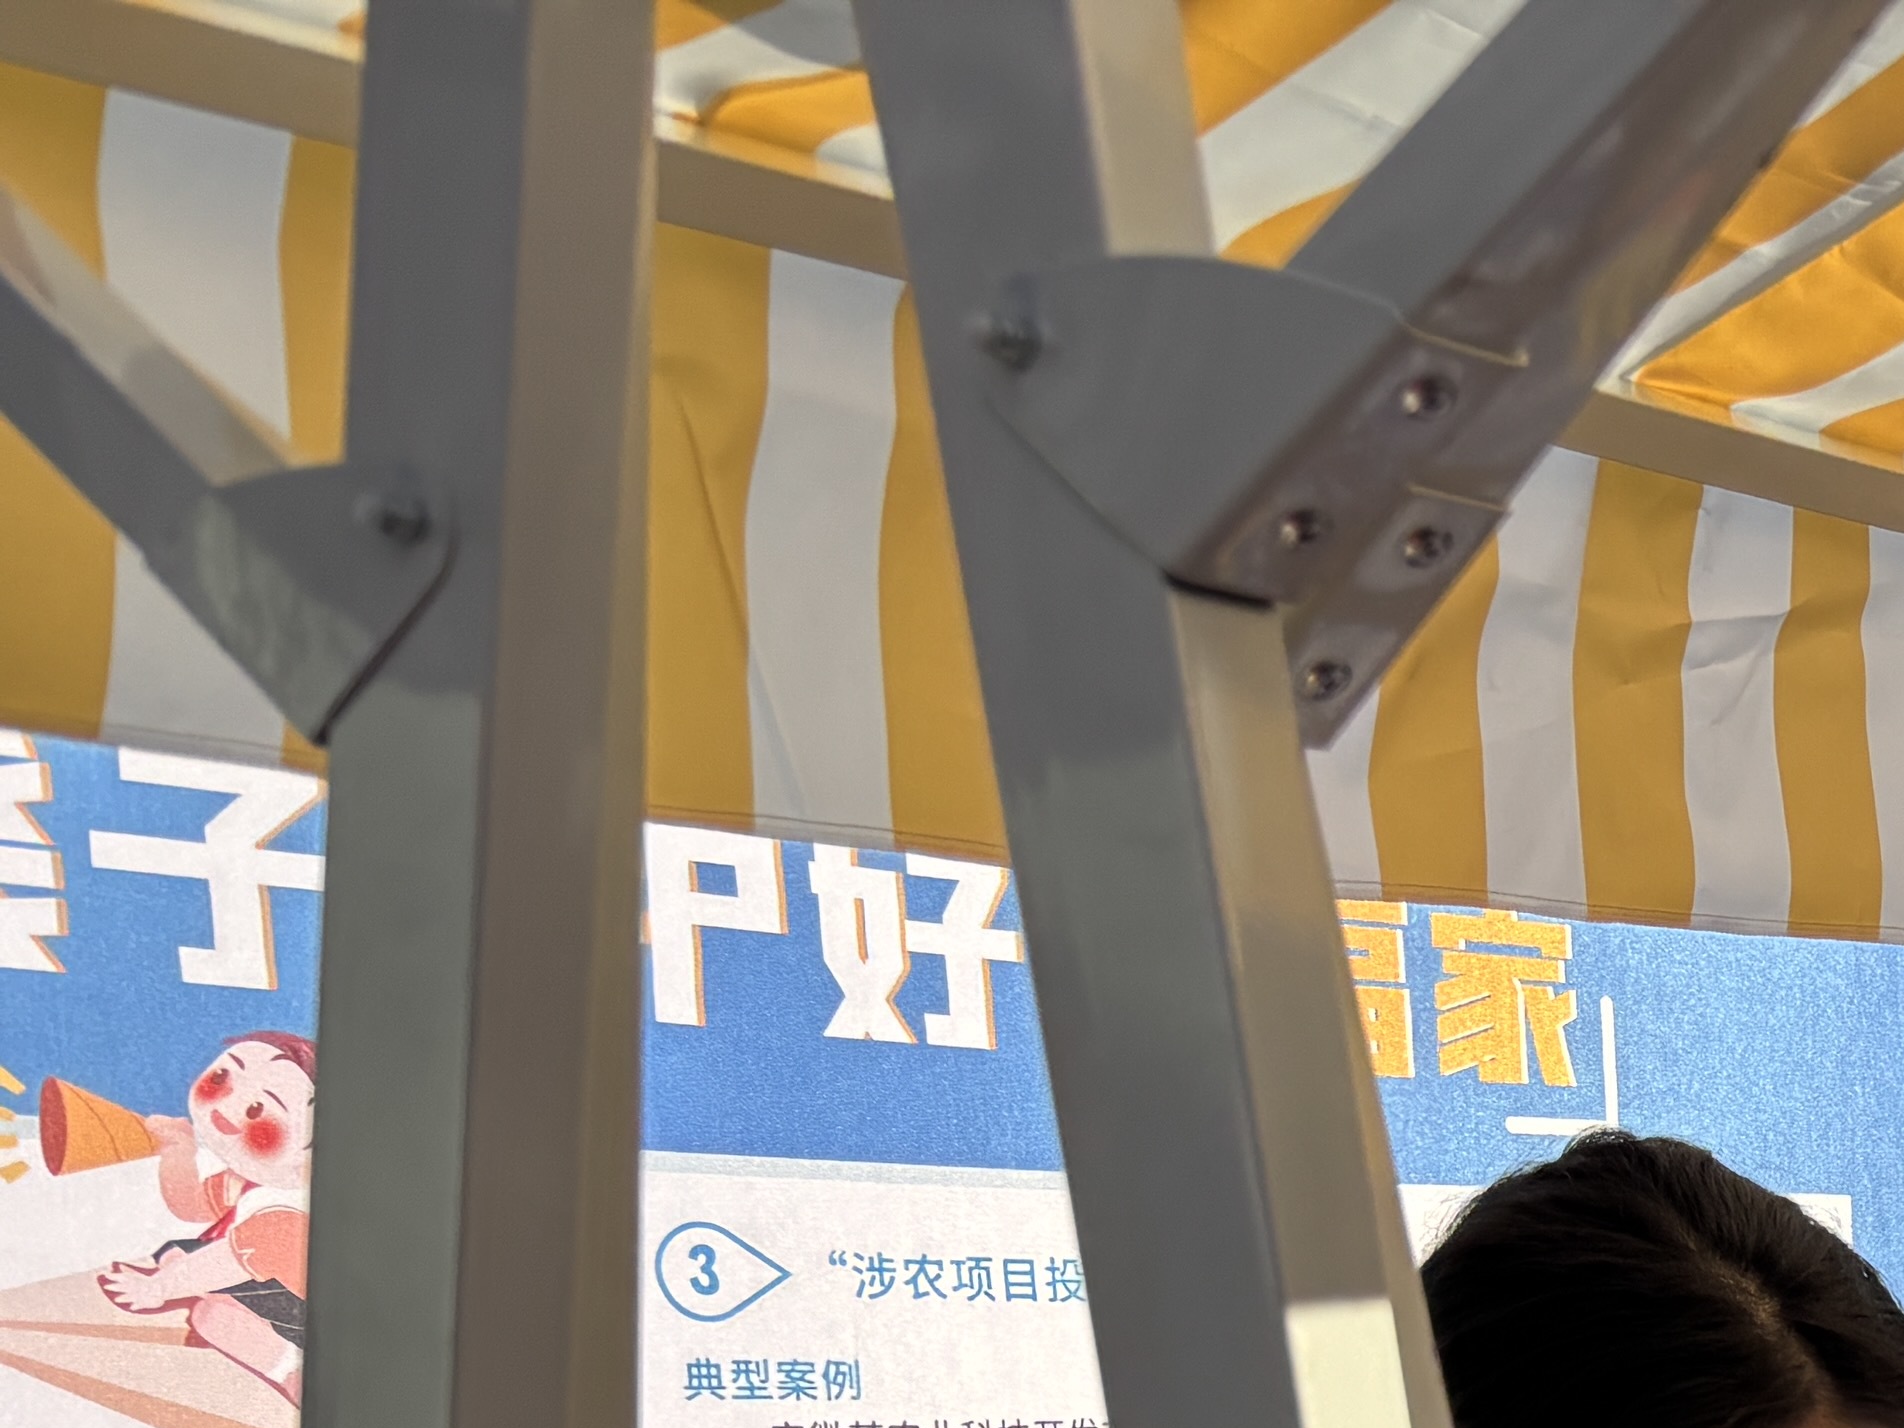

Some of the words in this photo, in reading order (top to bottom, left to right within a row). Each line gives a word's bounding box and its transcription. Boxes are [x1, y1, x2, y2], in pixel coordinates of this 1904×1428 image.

[687, 1243, 720, 1297] 3
[684, 1357, 862, 1402] 典型案例
